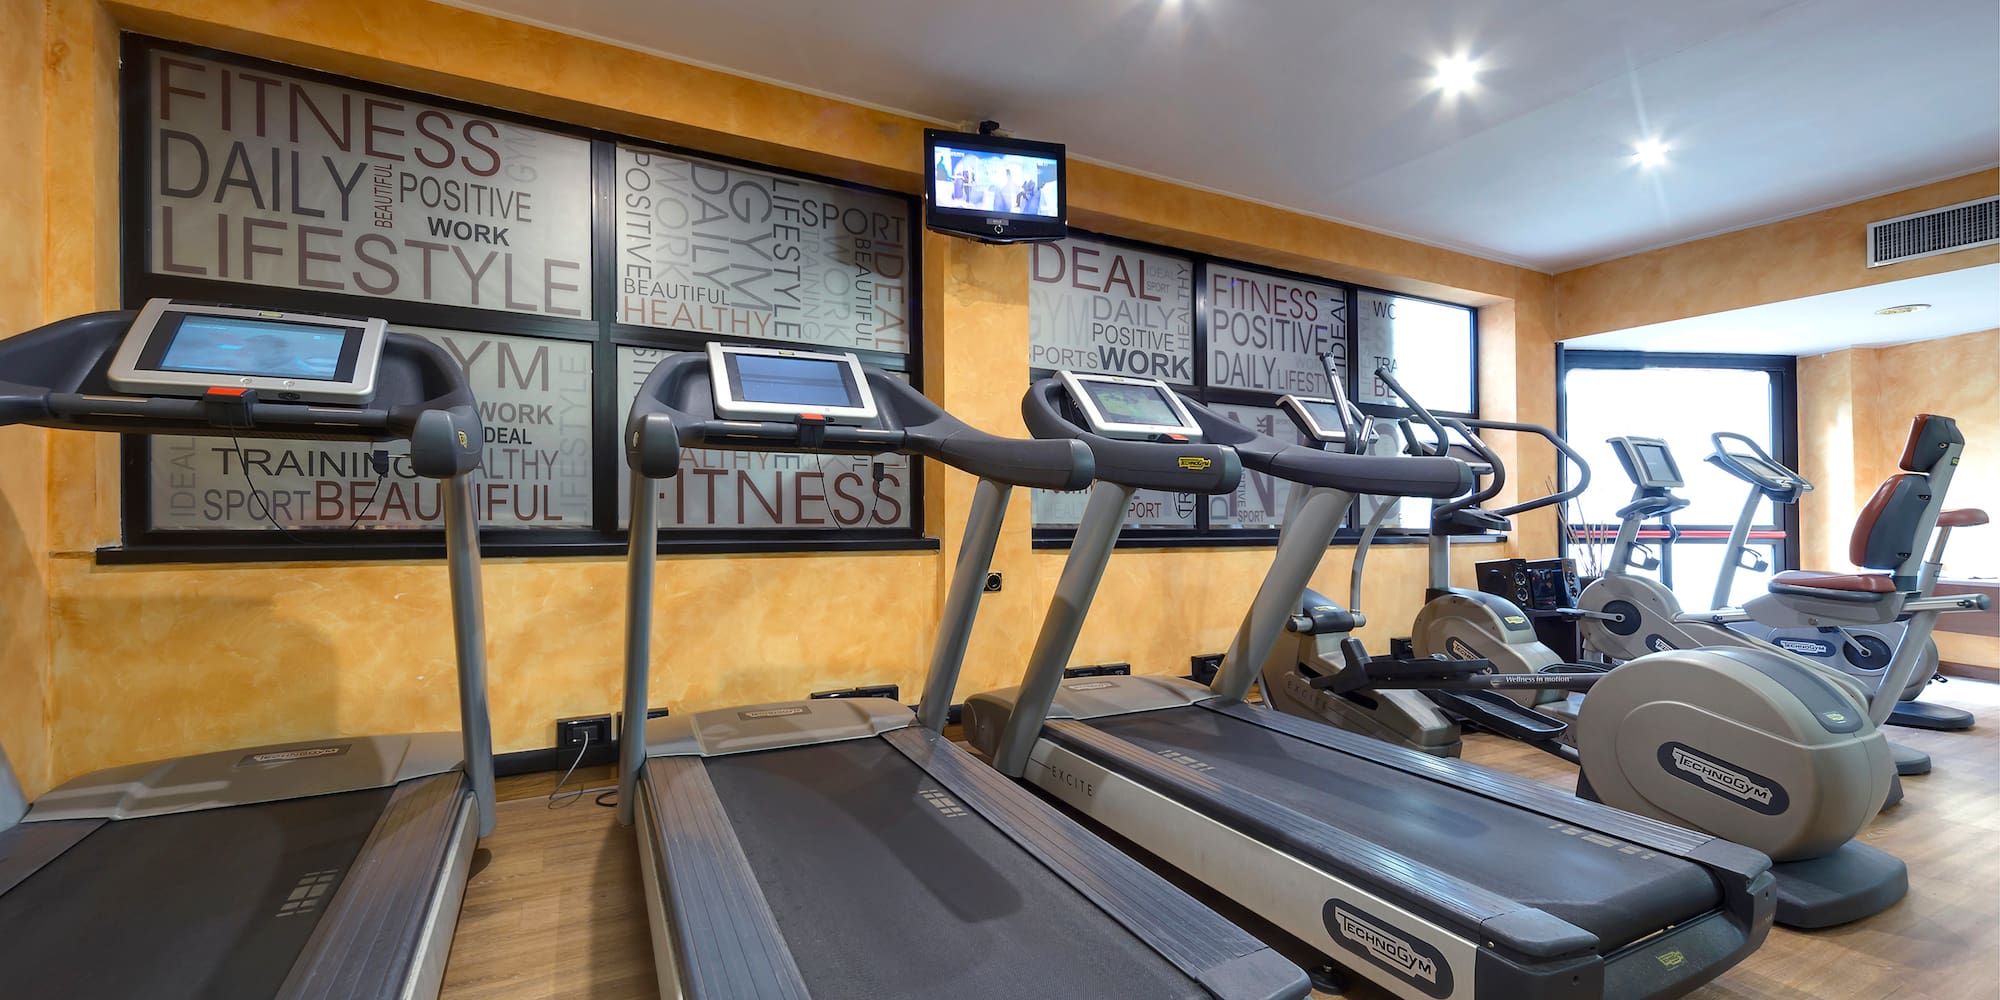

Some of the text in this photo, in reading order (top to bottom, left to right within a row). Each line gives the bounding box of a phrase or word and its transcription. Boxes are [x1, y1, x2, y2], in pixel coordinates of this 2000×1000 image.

[160, 57, 501, 177] FITNESS
[160, 128, 368, 222] DAILY
[374, 163, 393, 228] BEAUTIFUL
[400, 171, 533, 223] POSITIVE
[427, 216, 510, 247] WORK
[625, 151, 651, 279] POSITIVE
[655, 162, 689, 282] WORK
[691, 164, 730, 291] DAILY
[802, 199, 905, 242] SPORT
[162, 206, 582, 317] LIFESTYLE
[729, 180, 774, 312] GYM
[772, 177, 800, 339] LIFESTYLE
[624, 277, 730, 306] BEAUTIFUL
[801, 228, 821, 340] TRAINING
[823, 234, 851, 343] WORK
[854, 238, 872, 346] BEAUTIFUL
[874, 241, 905, 350] IDEAL
[1177, 263, 1190, 350] HEALTHY
[1213, 274, 1319, 322] FITNESS
[624, 295, 772, 337] HEALTHY
[1092, 322, 1174, 352] POSITIVE
[1093, 295, 1176, 330] DAILY
[1213, 309, 1328, 356] POSITIVE
[1330, 291, 1346, 368] IDEAL
[440, 336, 550, 392] YM
[1030, 344, 1098, 369] PORTS
[1098, 345, 1190, 380] WORK
[1214, 350, 1277, 390] DAILY
[170, 438, 196, 517] IDEAL
[203, 488, 311, 521] SPORT
[315, 480, 563, 522] BEAUIFUL
[660, 468, 902, 525] ITNESS
[1127, 502, 1161, 518] PORT
[1238, 510, 1264, 522] SPORT
[1052, 765, 1094, 797] EXCITE
